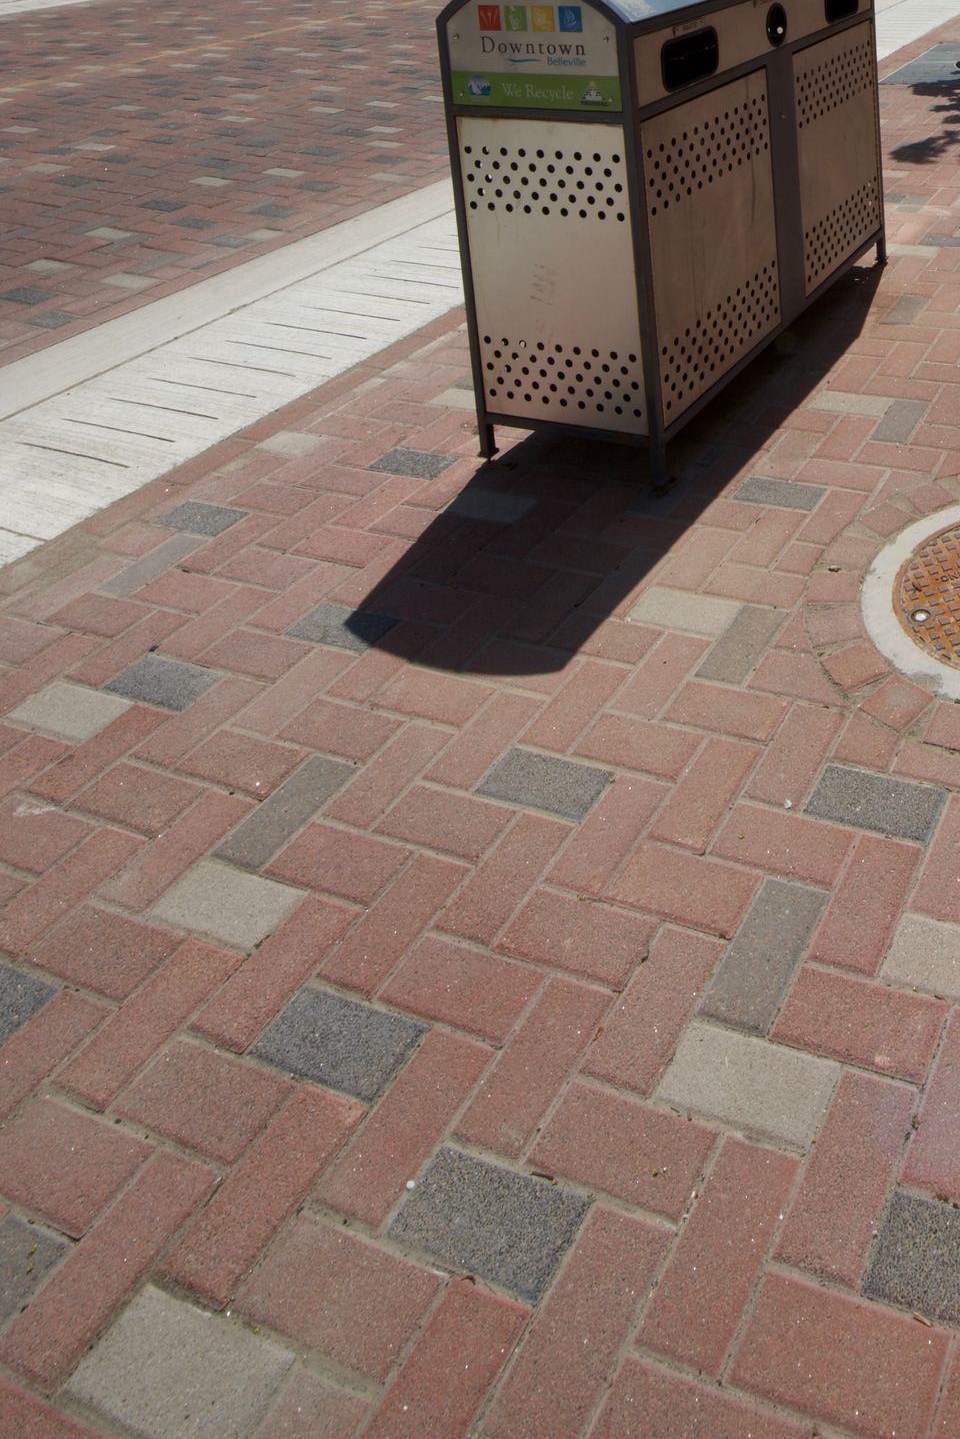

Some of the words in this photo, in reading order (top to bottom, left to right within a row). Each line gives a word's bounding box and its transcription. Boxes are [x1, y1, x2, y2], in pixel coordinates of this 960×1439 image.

[480, 36, 585, 56] Downtown
[547, 56, 587, 67] Belleville
[502, 83, 522, 98] We
[526, 84, 574, 101] Recycle
